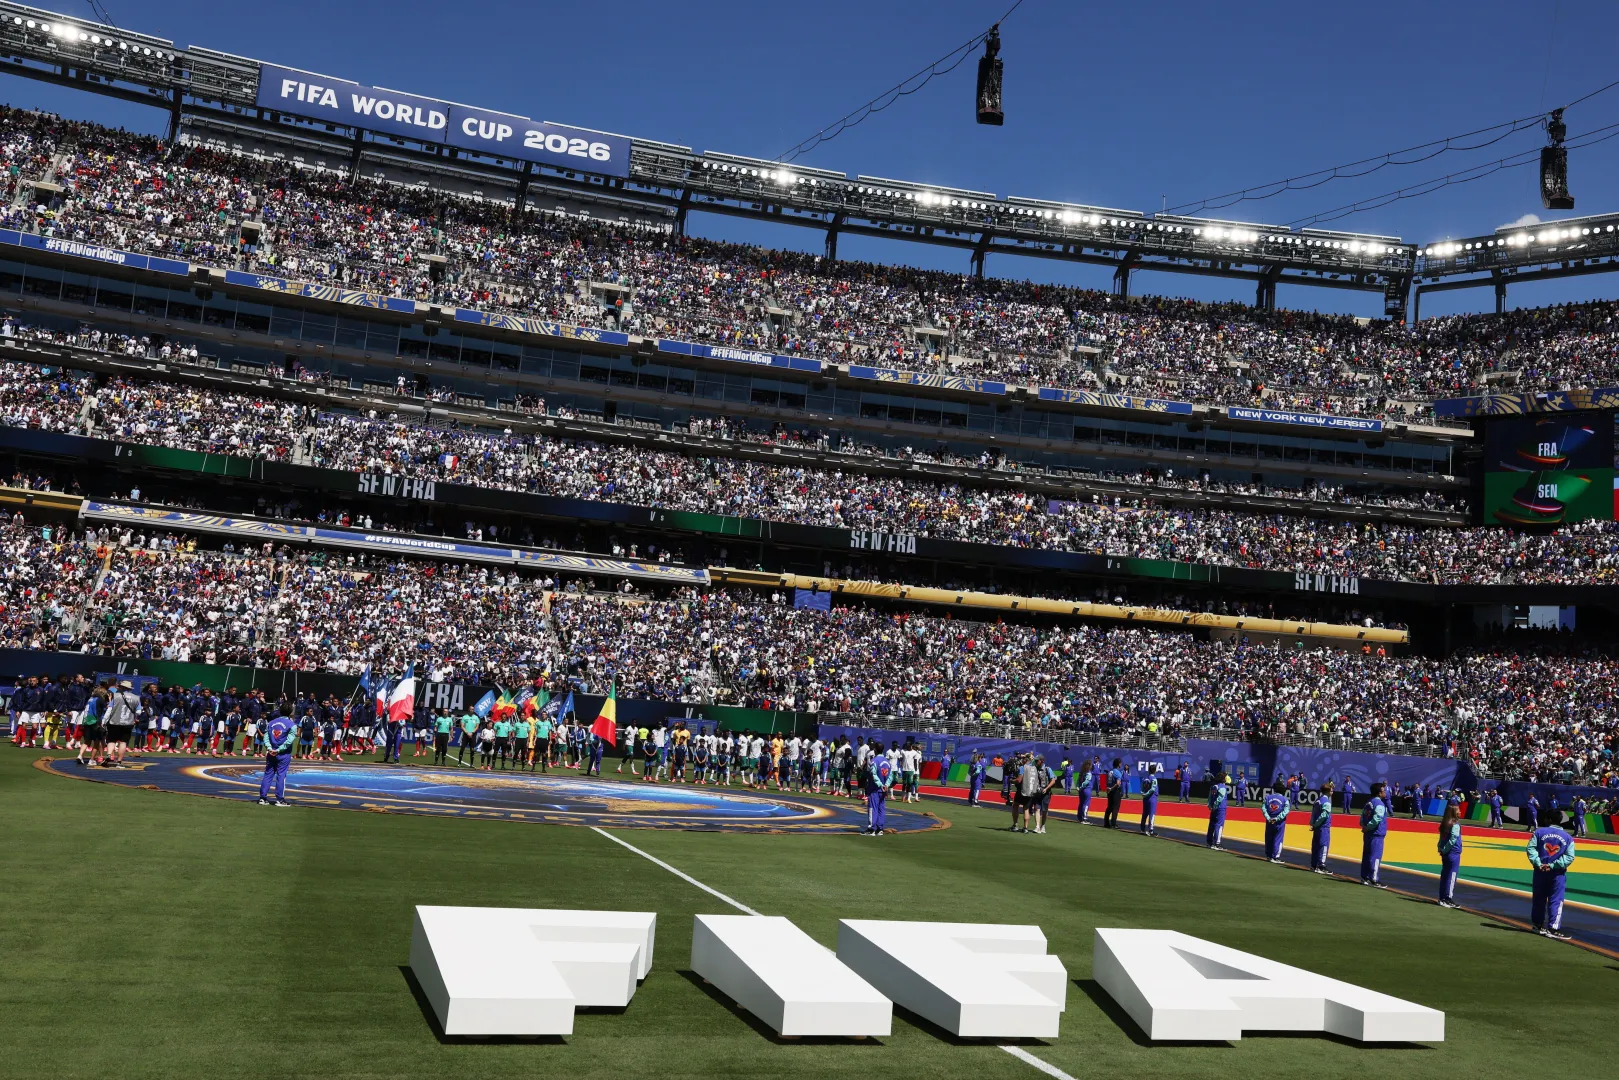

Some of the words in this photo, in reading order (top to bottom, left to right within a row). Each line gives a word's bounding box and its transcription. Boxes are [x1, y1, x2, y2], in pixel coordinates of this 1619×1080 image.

[281, 79, 339, 109] FIFA
[351, 94, 447, 129] WORLD
[462, 117, 513, 142] CUP
[524, 130, 611, 162] 2026
[46, 239, 125, 264] #FIFAWorldCup
[711, 348, 771, 365] #FIFAWorldCup
[1235, 410, 1261, 418] NEW
[1265, 413, 1297, 422] YORK
[1300, 416, 1326, 424] NEW
[1328, 419, 1375, 428] JERSEY
[1538, 442, 1557, 456] FRA
[1538, 484, 1557, 498] SEN
[365, 535, 456, 550] #FIFAWorldCup
[410, 905, 1445, 1042] FIFA
